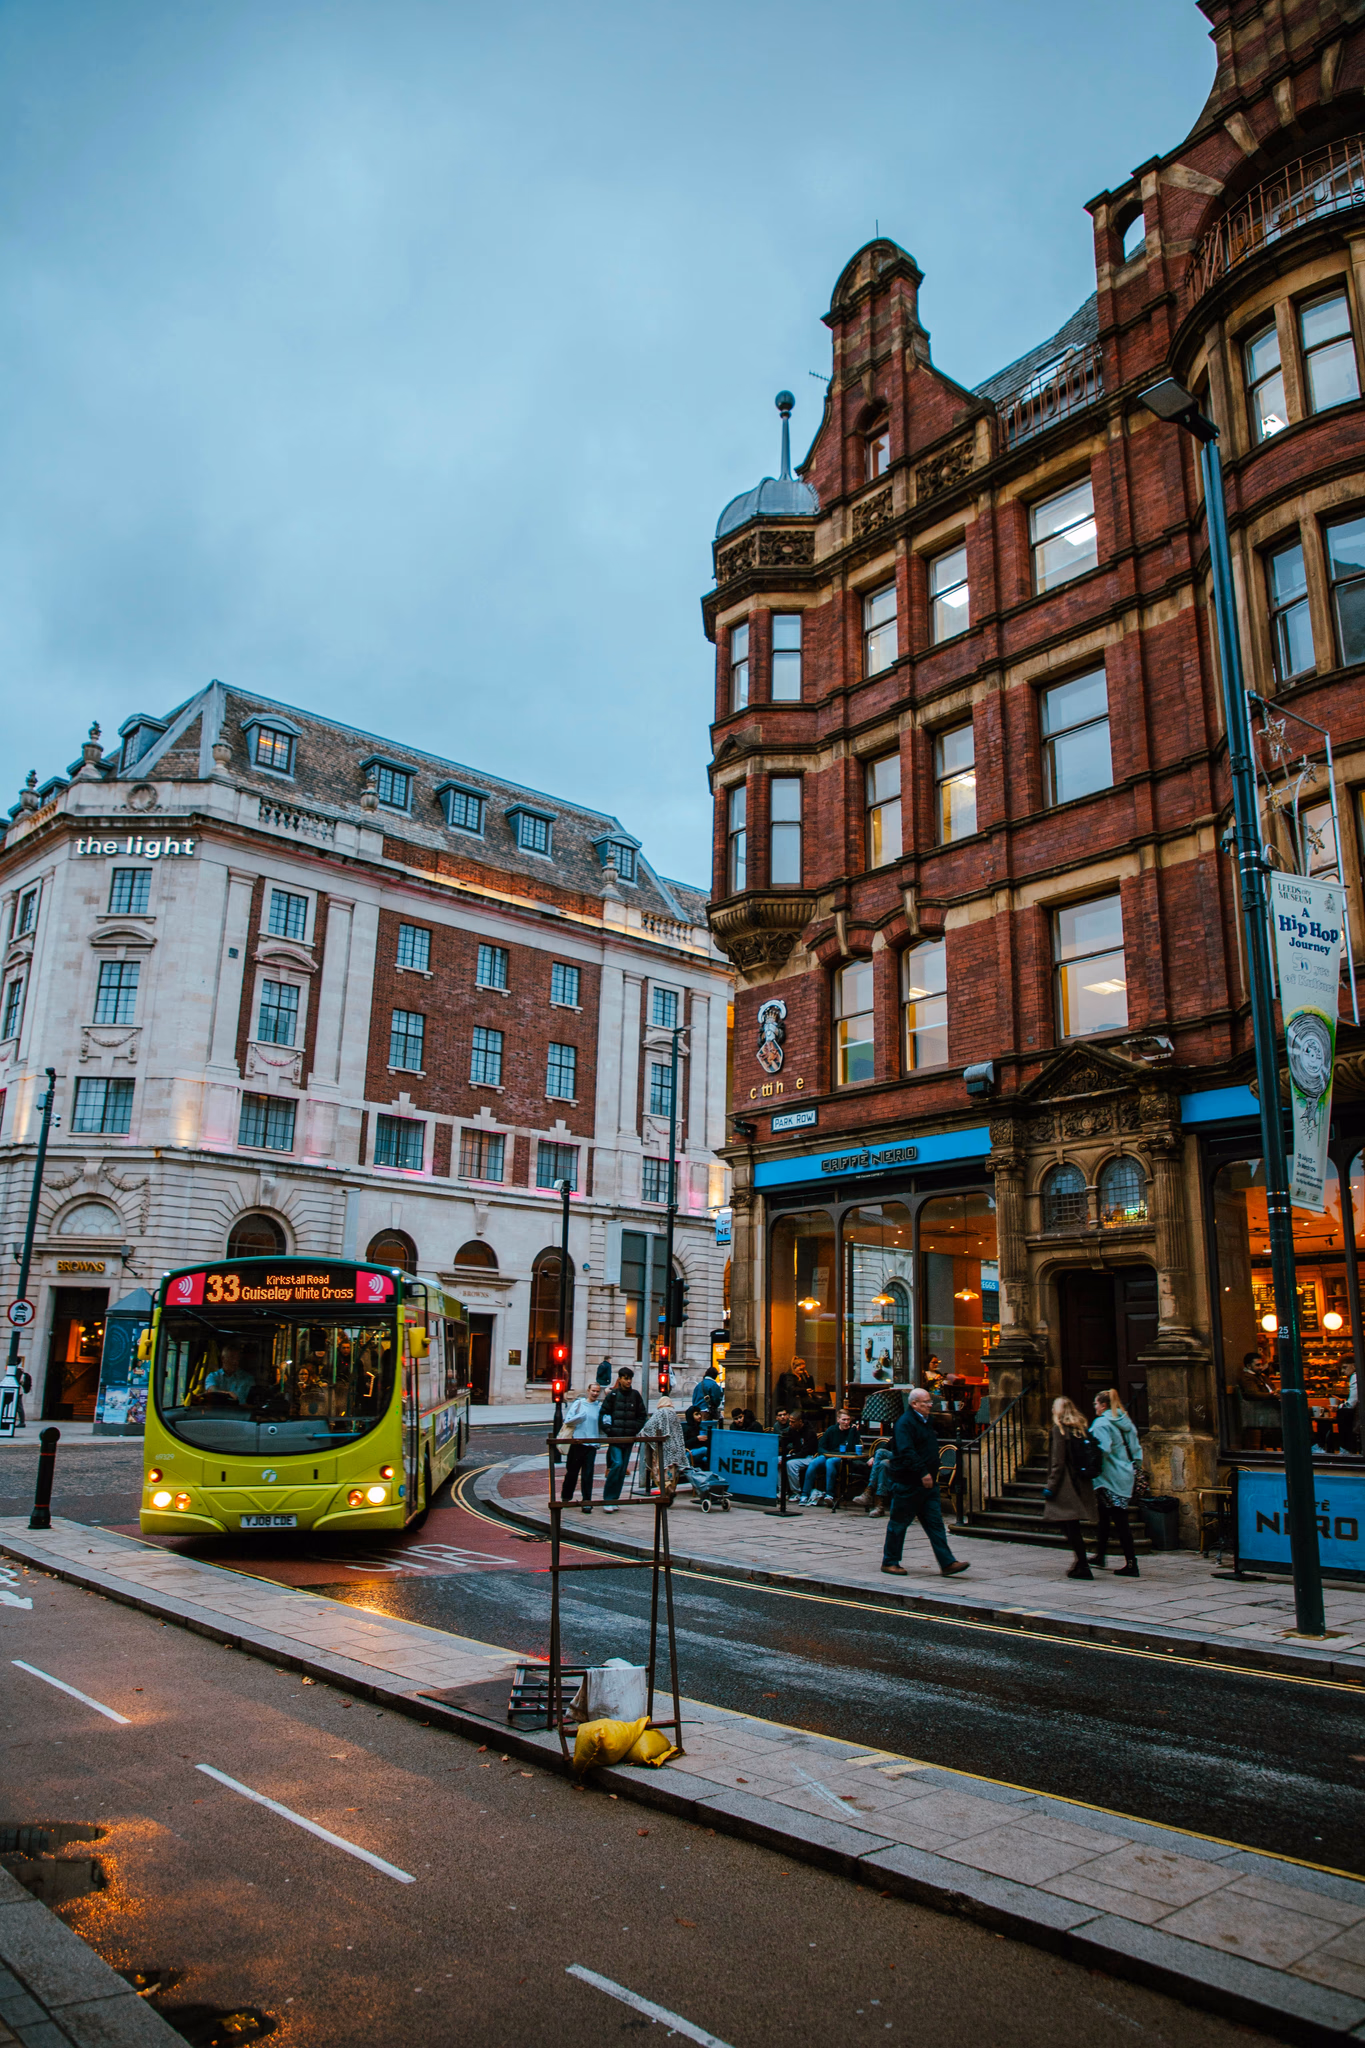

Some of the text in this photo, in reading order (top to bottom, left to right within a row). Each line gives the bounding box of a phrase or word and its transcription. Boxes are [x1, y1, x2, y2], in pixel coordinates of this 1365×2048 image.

[75, 836, 194, 860] the light
[1278, 883, 1301, 894] LEEDS
[1279, 891, 1312, 905] MUSEUM
[1301, 907, 1310, 918] A
[1278, 914, 1339, 944] Hip Hop
[1289, 937, 1331, 956] Journey
[774, 1112, 814, 1129] PARK ROW
[871, 1145, 918, 1165] NERO
[717, 1227, 731, 1236] NE
[56, 1259, 106, 1273] BROWNS
[206, 1274, 330, 1303] 33 Kirkstall Road
[241, 1286, 292, 1301] Guiseley
[294, 1286, 320, 1300] White
[321, 1286, 354, 1300] Cross
[462, 1290, 490, 1298] BROWNS
[1278, 1325, 1289, 1335] 25
[718, 1457, 768, 1477] NERO
[273, 1515, 293, 1526] CDE
